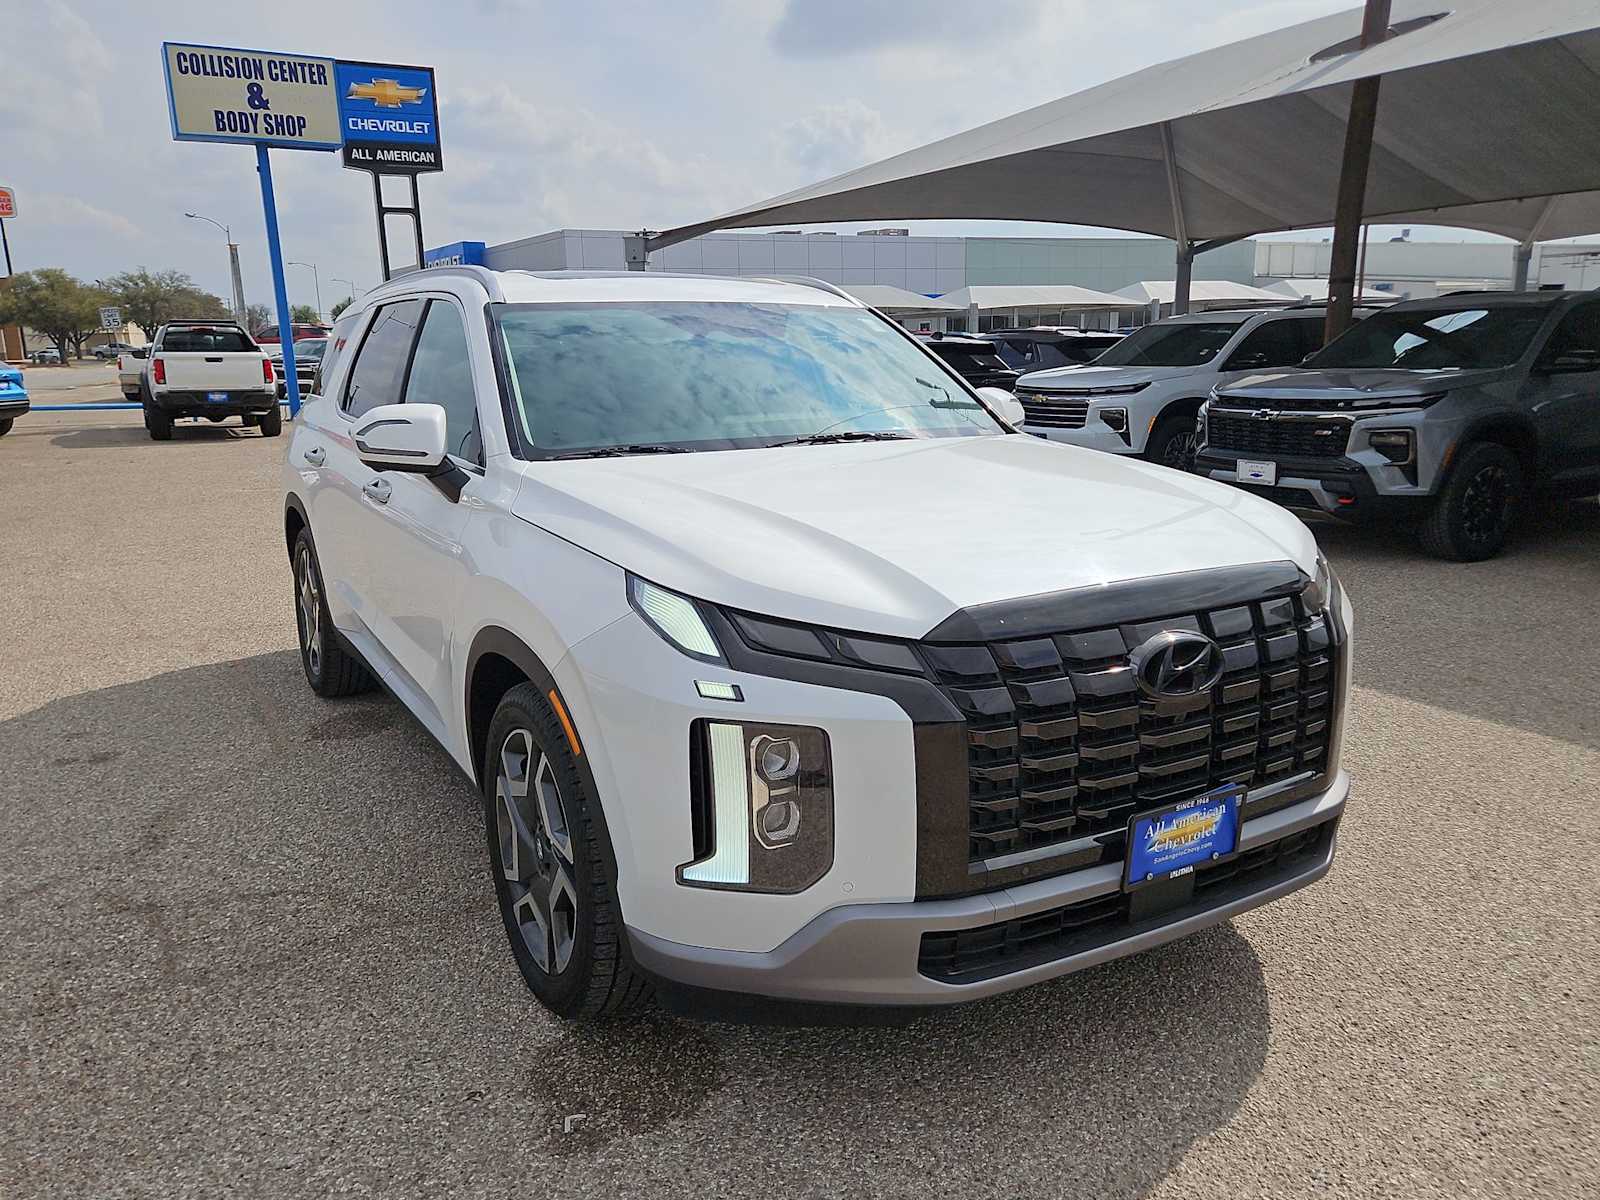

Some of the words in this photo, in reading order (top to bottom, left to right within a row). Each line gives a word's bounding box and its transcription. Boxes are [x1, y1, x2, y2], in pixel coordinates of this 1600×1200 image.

[176, 51, 265, 81] COLLISION
[267, 58, 328, 86] CENTER
[246, 82, 271, 111] &
[213, 109, 259, 134] BODY
[263, 113, 307, 137] SHOP
[348, 117, 430, 134] CHEVROLET
[351, 148, 373, 161] ALL
[376, 149, 435, 163] AMERICAN
[104, 318, 120, 327] 35
[1175, 800, 1195, 812] SINCE
[1144, 820, 1165, 839] All
[1170, 803, 1226, 830] American
[1153, 823, 1217, 853] Chevrolet
